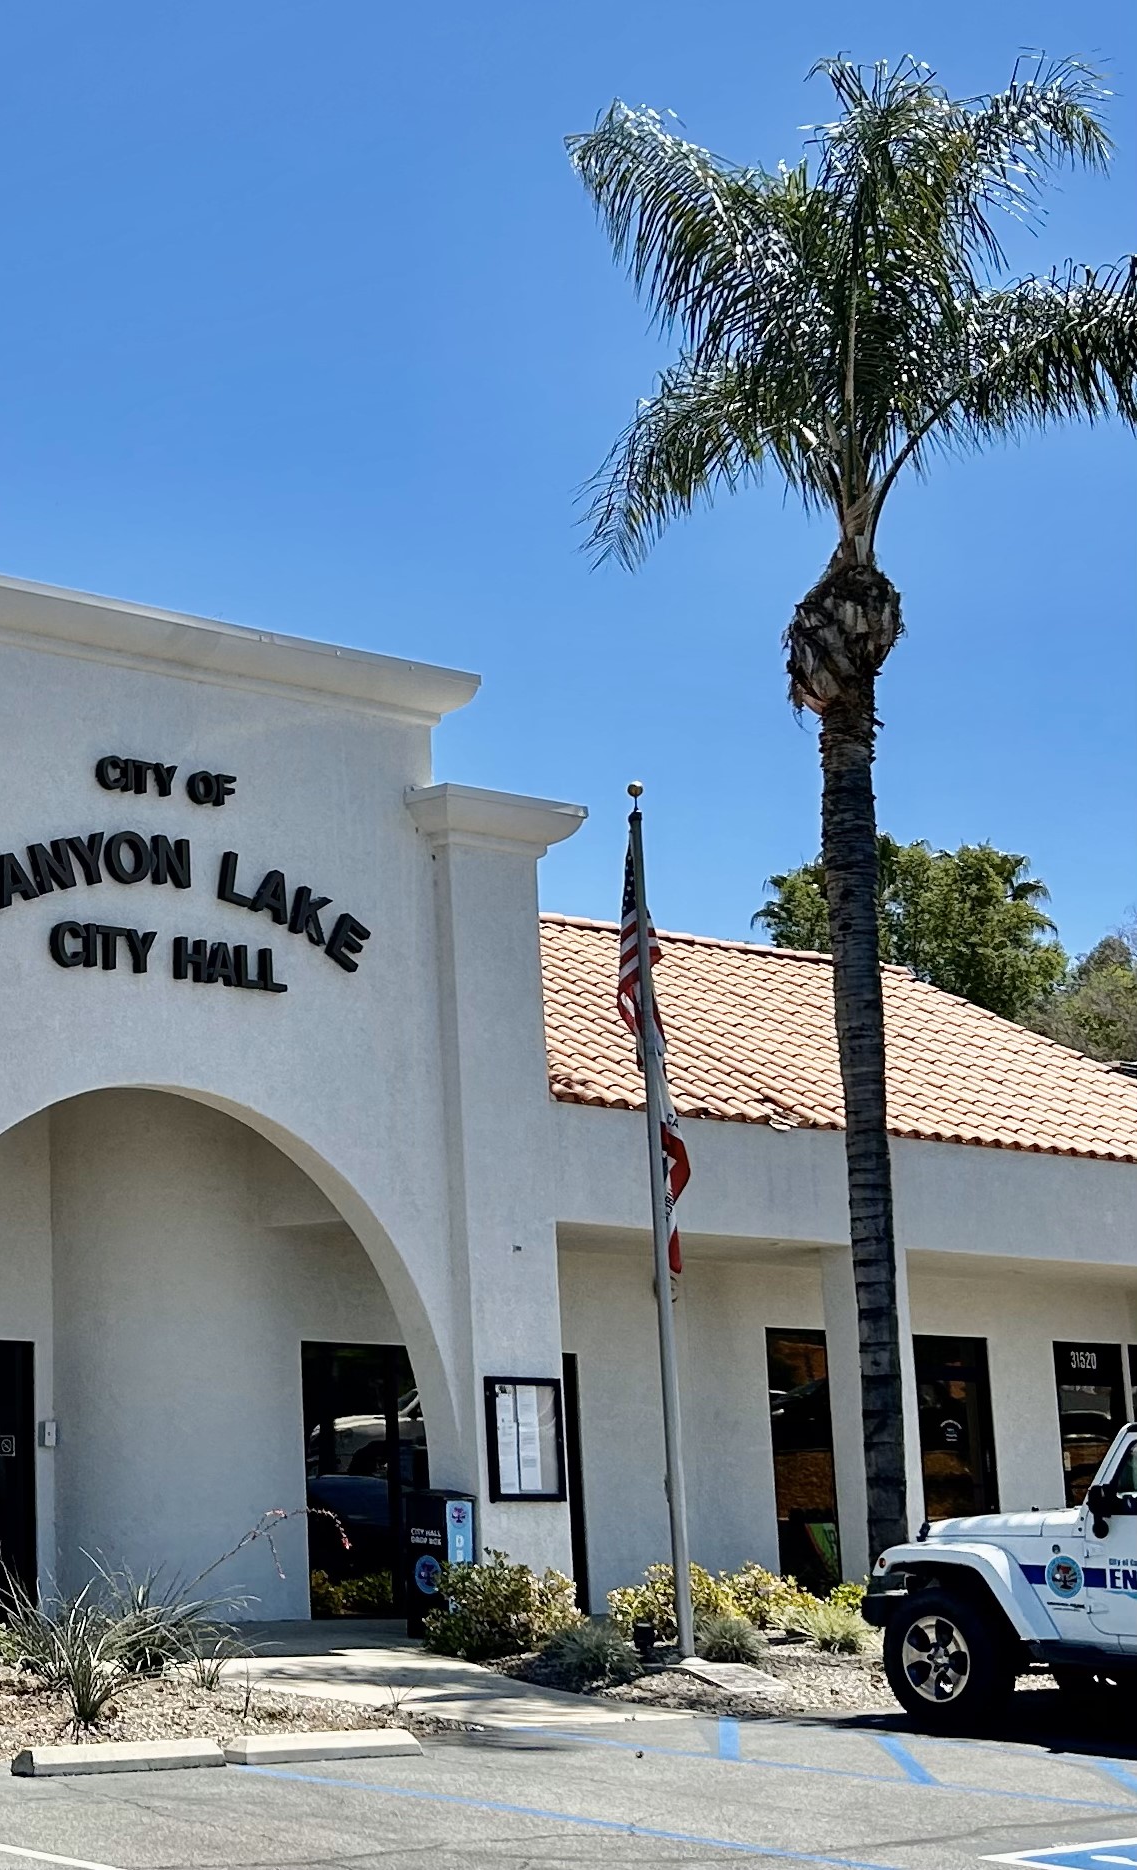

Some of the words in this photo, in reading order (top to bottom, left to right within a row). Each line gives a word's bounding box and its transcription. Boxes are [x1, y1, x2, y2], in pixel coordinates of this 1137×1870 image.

[95, 755, 178, 797] CITY
[186, 770, 237, 807] OF
[217, 850, 372, 973] LAKE
[49, 920, 158, 974] CITY
[173, 935, 288, 993] HALL
[1070, 1351, 1097, 1370] 31520
